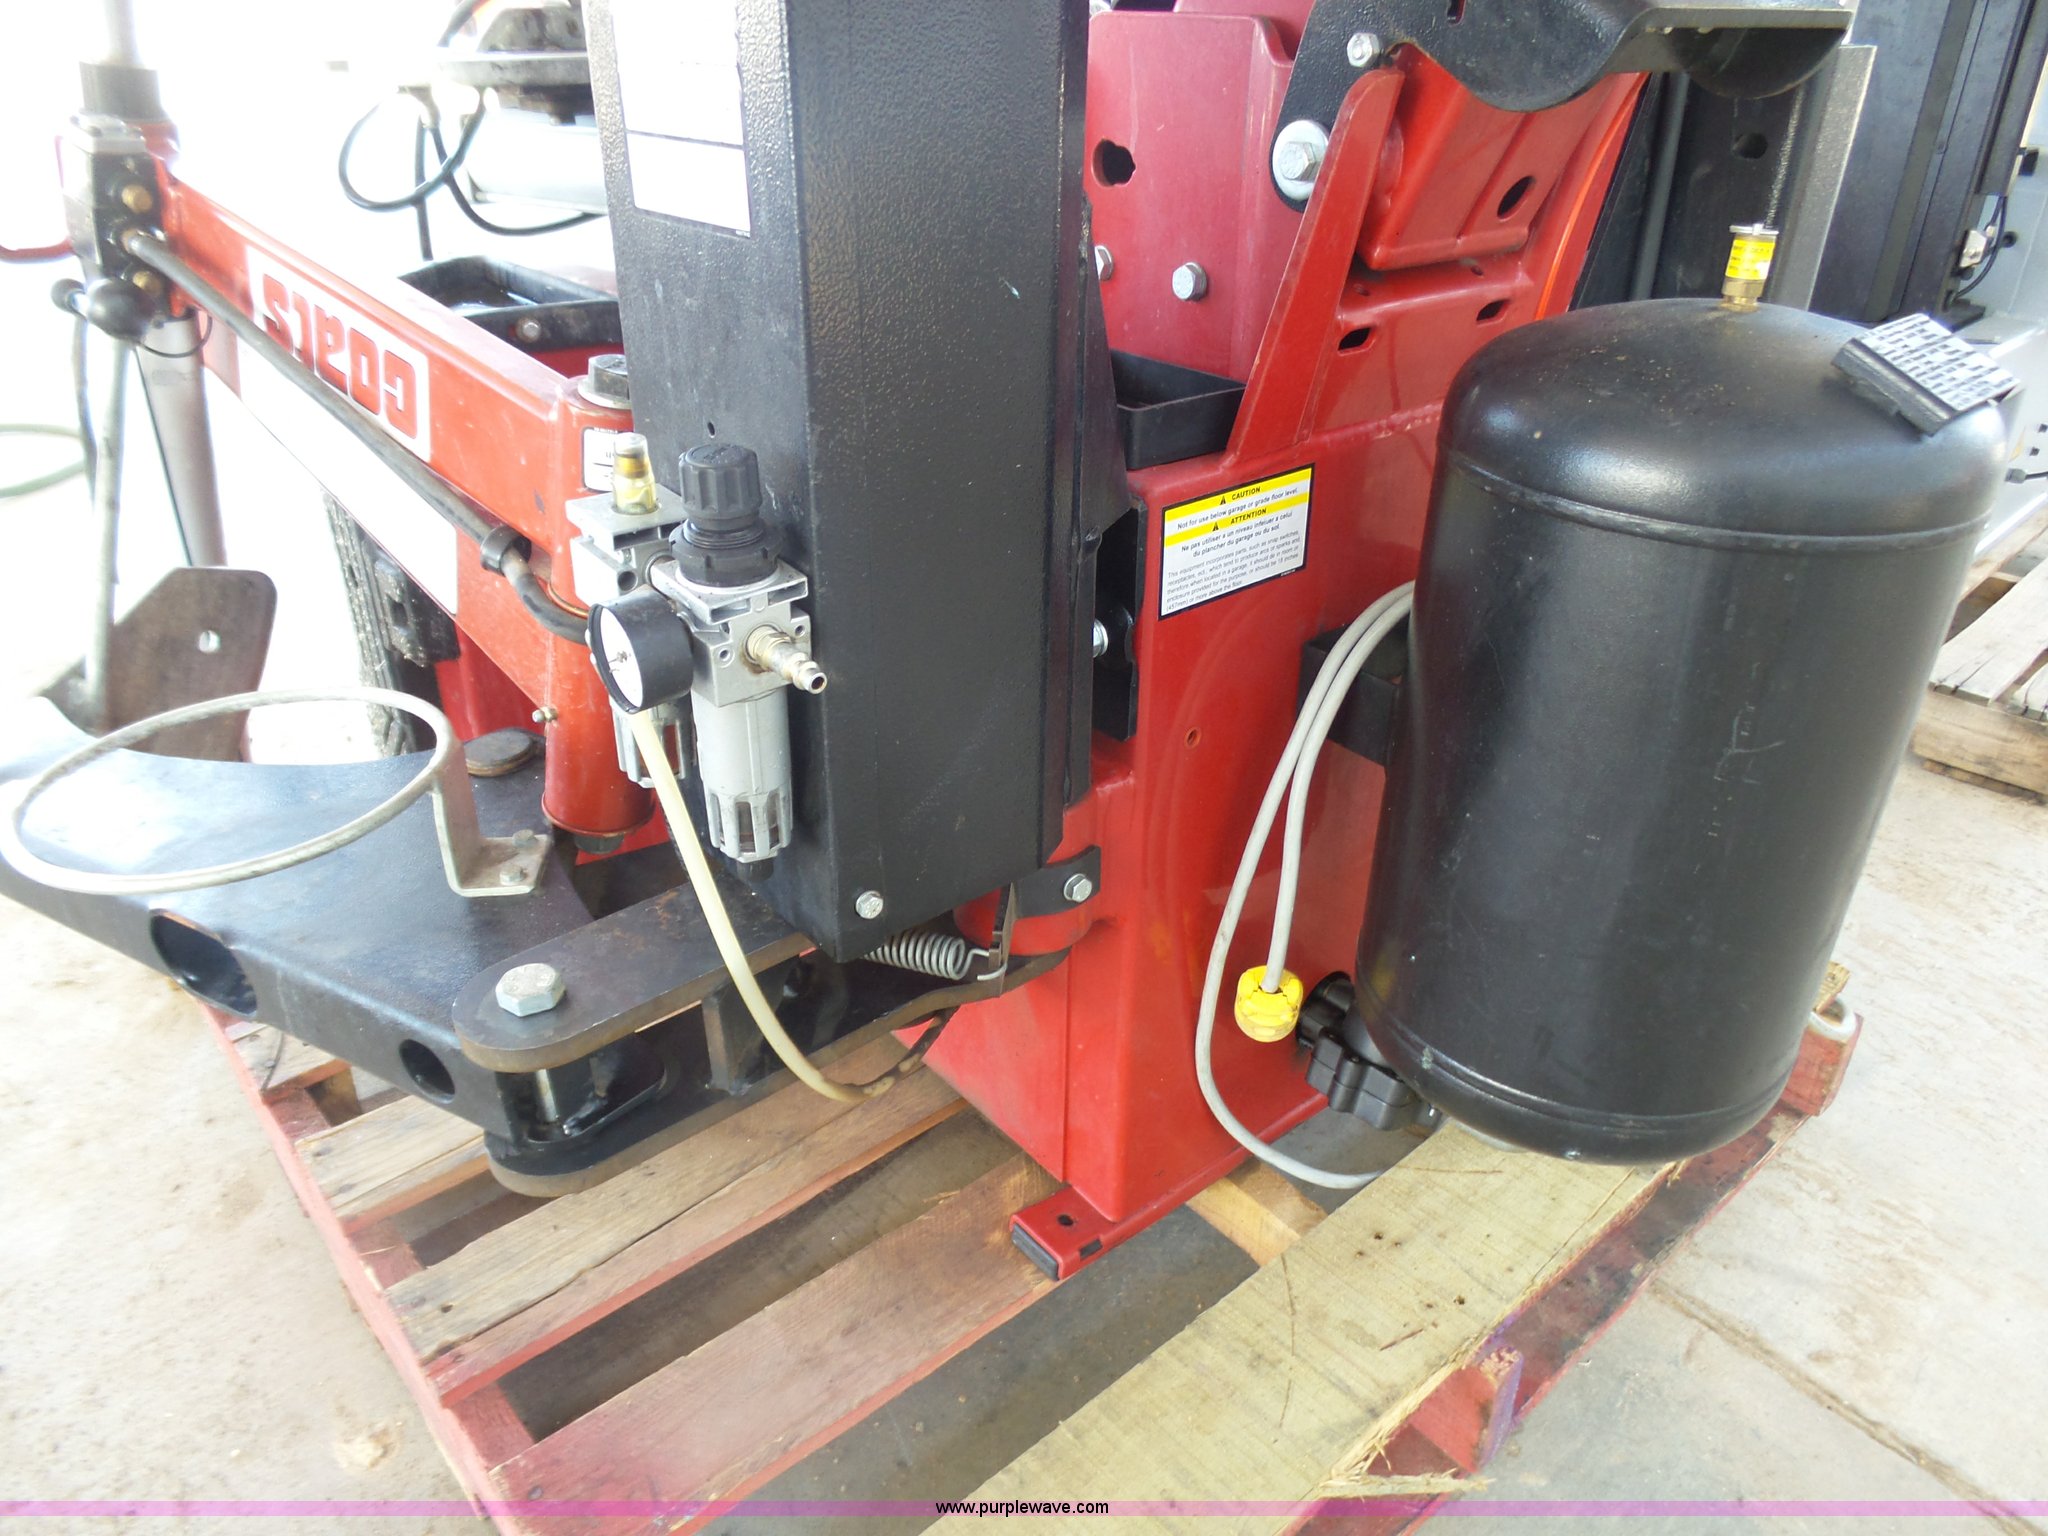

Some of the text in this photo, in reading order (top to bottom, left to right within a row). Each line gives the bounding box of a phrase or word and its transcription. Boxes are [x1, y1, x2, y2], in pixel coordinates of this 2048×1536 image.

[1231, 486, 1260, 500] CAUTION
[1210, 511, 1226, 519] below
[1228, 504, 1246, 515] garage
[1255, 497, 1270, 507] grade
[1271, 492, 1284, 500] floor
[1230, 508, 1266, 524] ATTENTION
[1190, 542, 1200, 550] pas
[1202, 535, 1221, 545] utiliser
[1235, 525, 1253, 533] niveau
[1201, 542, 1226, 555] plancher
[1235, 533, 1253, 544] garage
